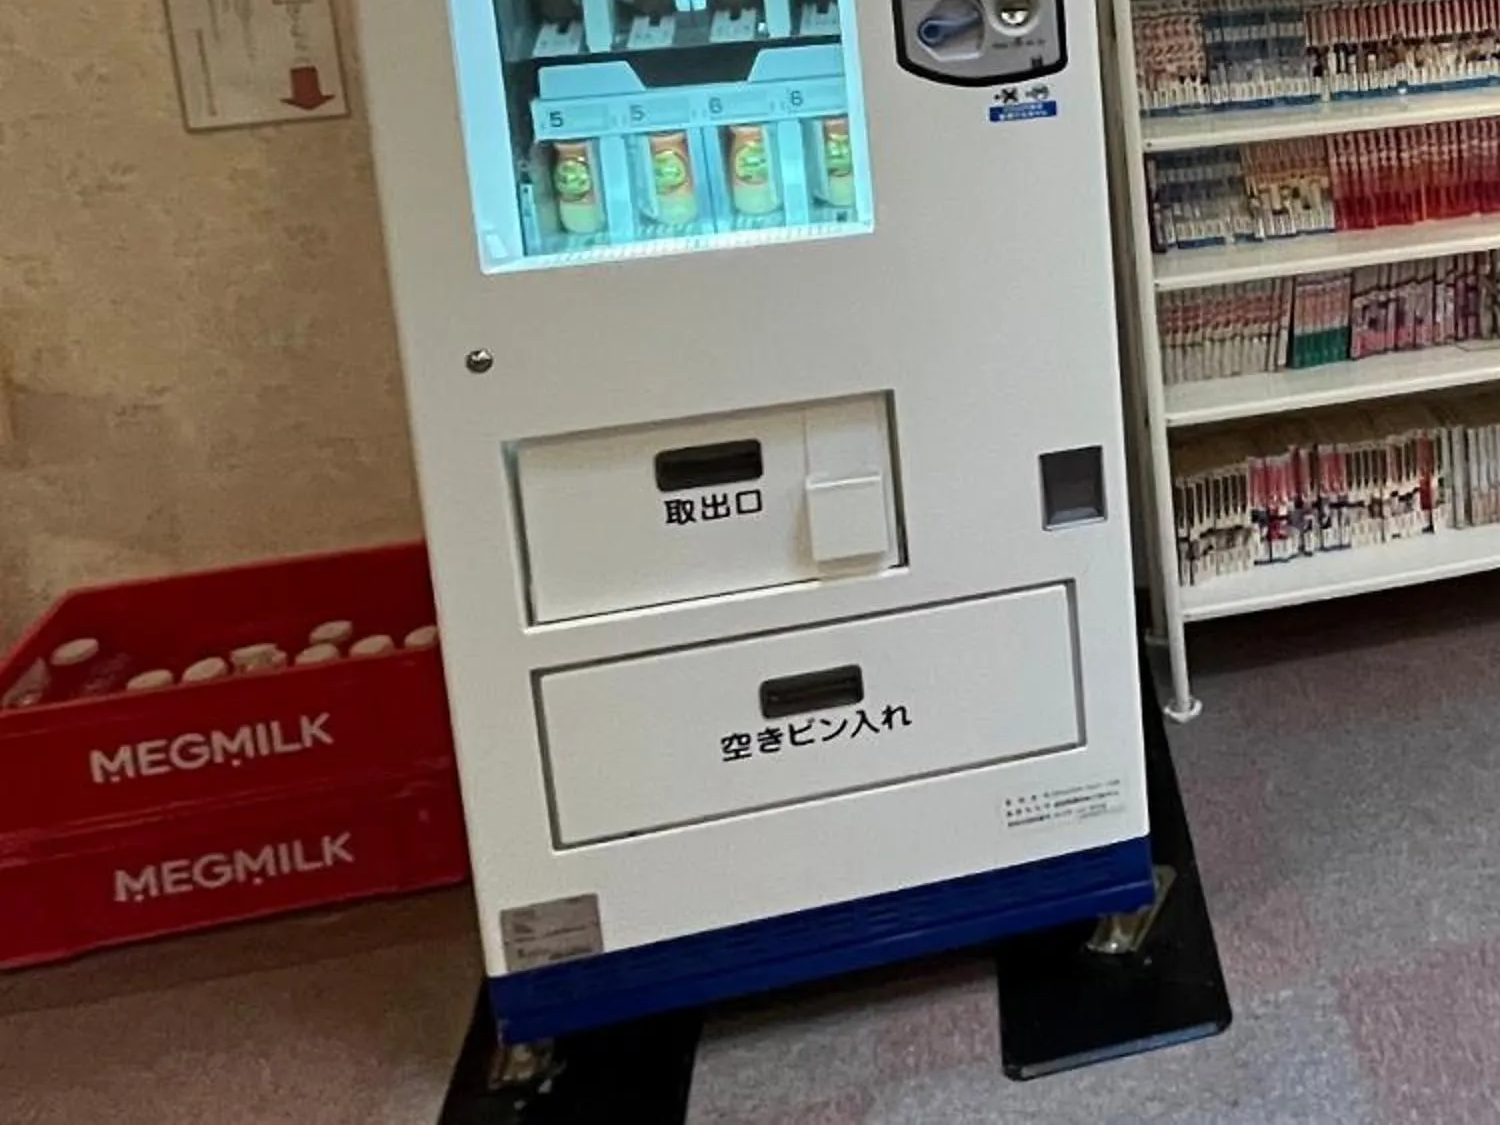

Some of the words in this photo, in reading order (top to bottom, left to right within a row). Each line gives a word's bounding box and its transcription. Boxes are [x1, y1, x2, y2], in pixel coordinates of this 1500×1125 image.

[629, 104, 645, 122] 5
[708, 97, 724, 115] 6
[789, 90, 805, 107] 6
[548, 109, 566, 129] 5
[664, 488, 765, 527] 取出口
[89, 712, 335, 784] MEGMILK
[720, 704, 914, 764] 空きビン入れ
[113, 831, 355, 903] MEGMILK
